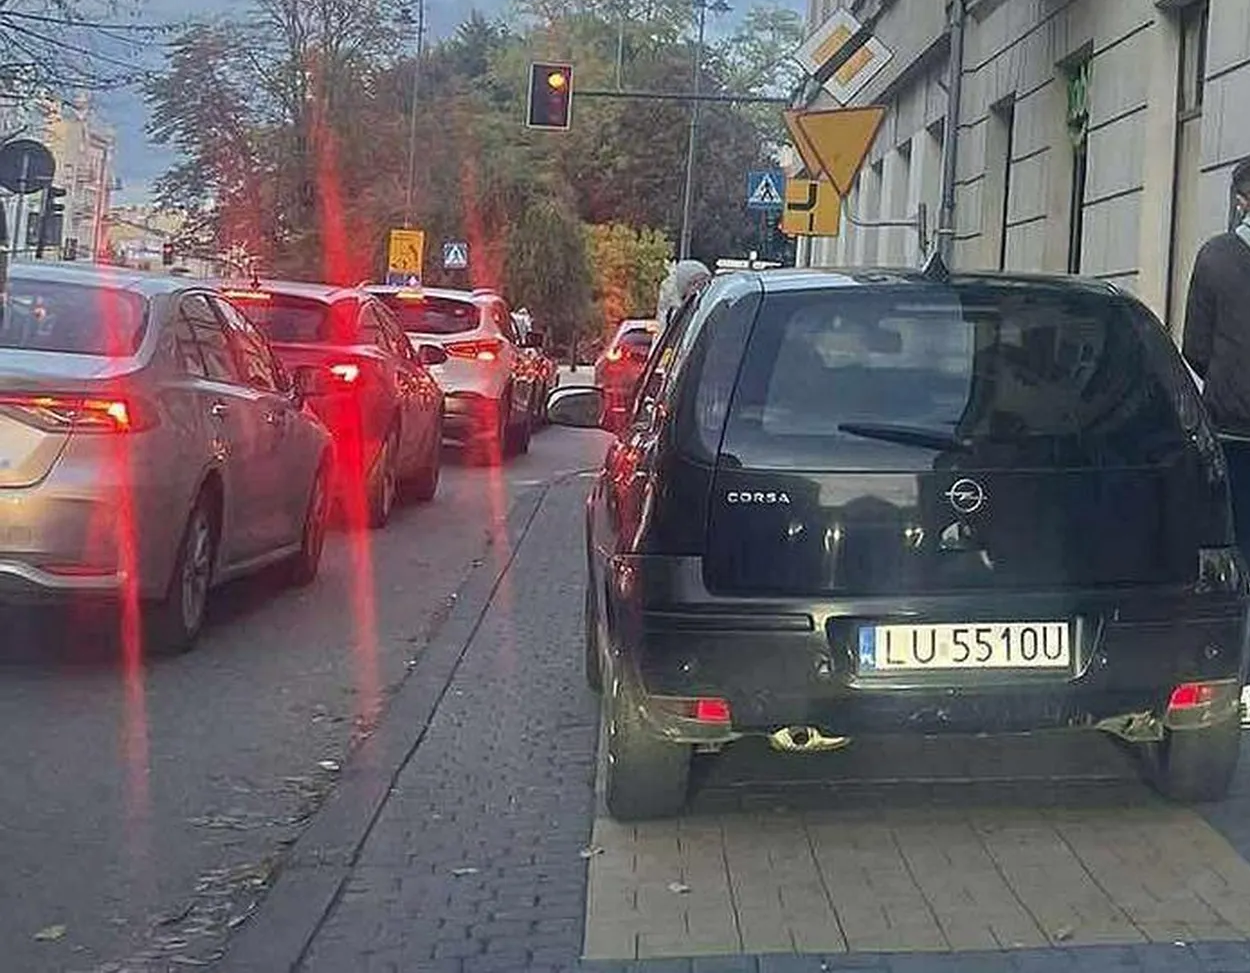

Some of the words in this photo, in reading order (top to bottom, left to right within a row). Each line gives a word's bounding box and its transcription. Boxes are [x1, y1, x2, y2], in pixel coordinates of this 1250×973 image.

[726, 491, 791, 505] CORSA
[886, 629, 937, 665] LU
[952, 626, 1063, 663] 5510U
